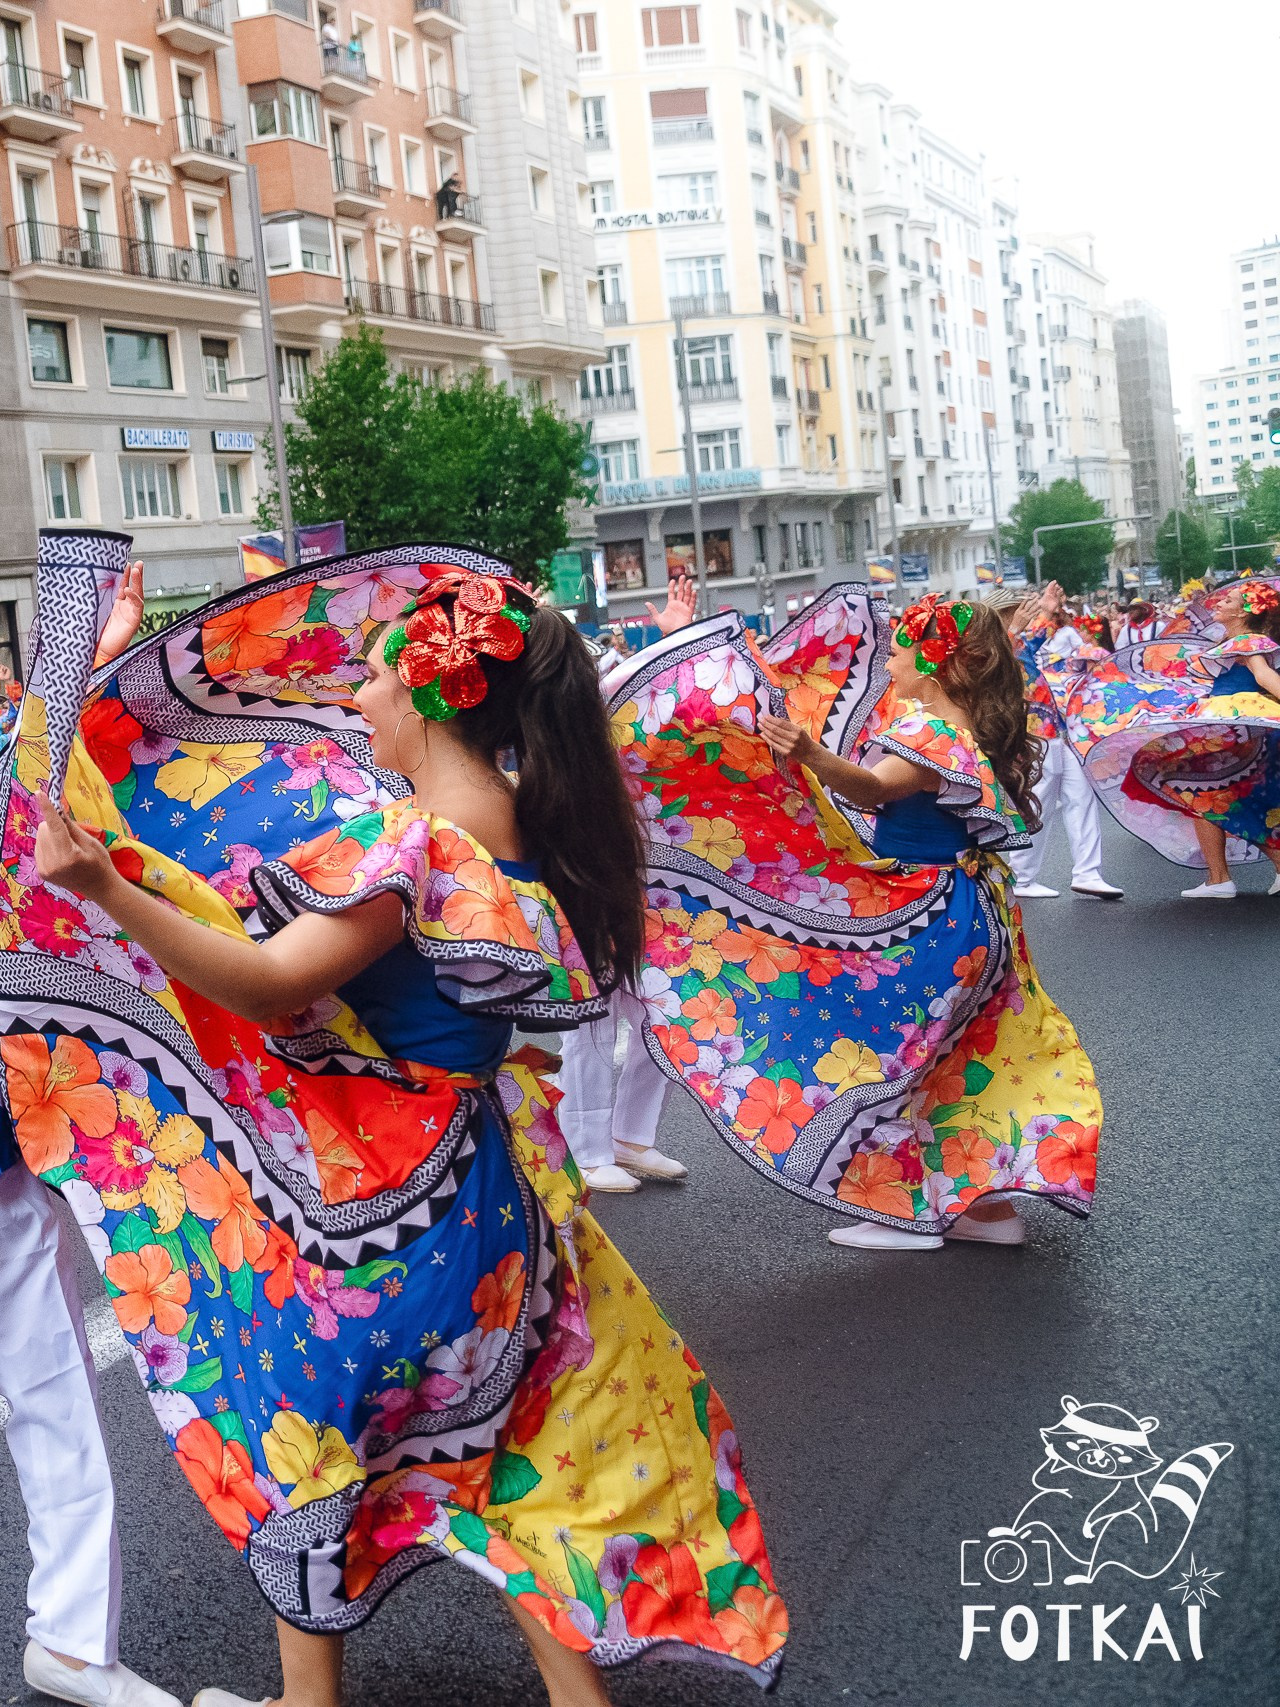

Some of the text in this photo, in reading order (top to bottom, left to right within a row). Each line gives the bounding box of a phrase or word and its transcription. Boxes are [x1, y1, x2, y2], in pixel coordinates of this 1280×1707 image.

[657, 208, 710, 224] BOUTIQUE
[127, 429, 188, 447] BACHILLERATO
[217, 432, 253, 448] TURISMO
